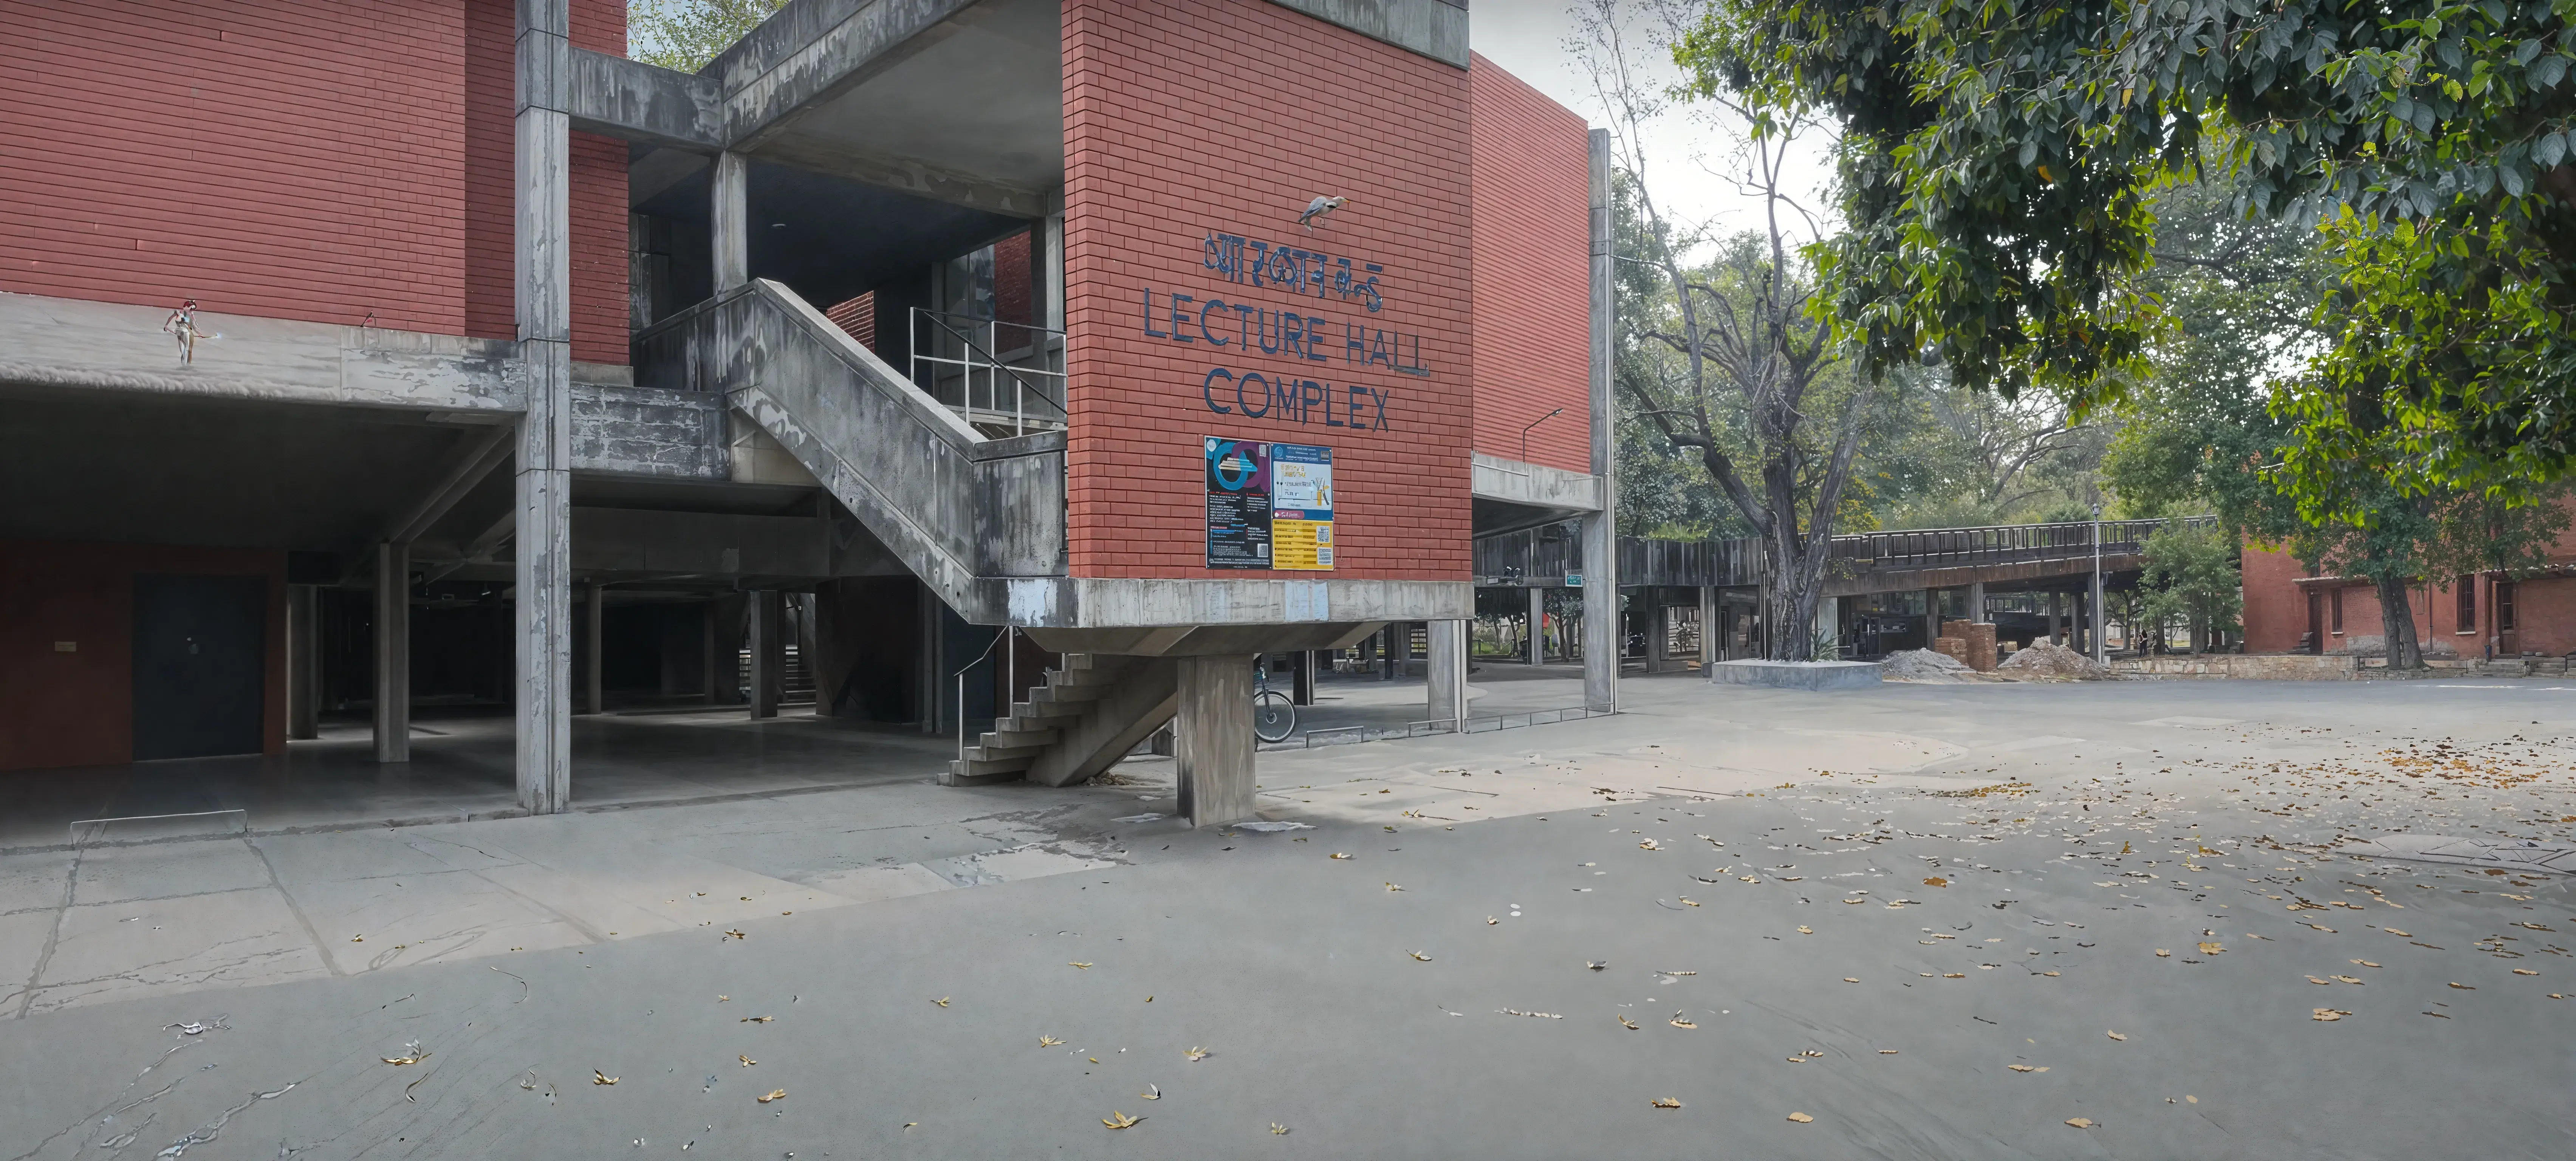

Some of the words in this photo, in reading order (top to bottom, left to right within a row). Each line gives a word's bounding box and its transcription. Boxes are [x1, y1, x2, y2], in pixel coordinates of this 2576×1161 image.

[1144, 288, 1327, 362] LECTURE
[1346, 322, 1430, 377] HALL
[1204, 367, 1389, 433] COMPLEX
